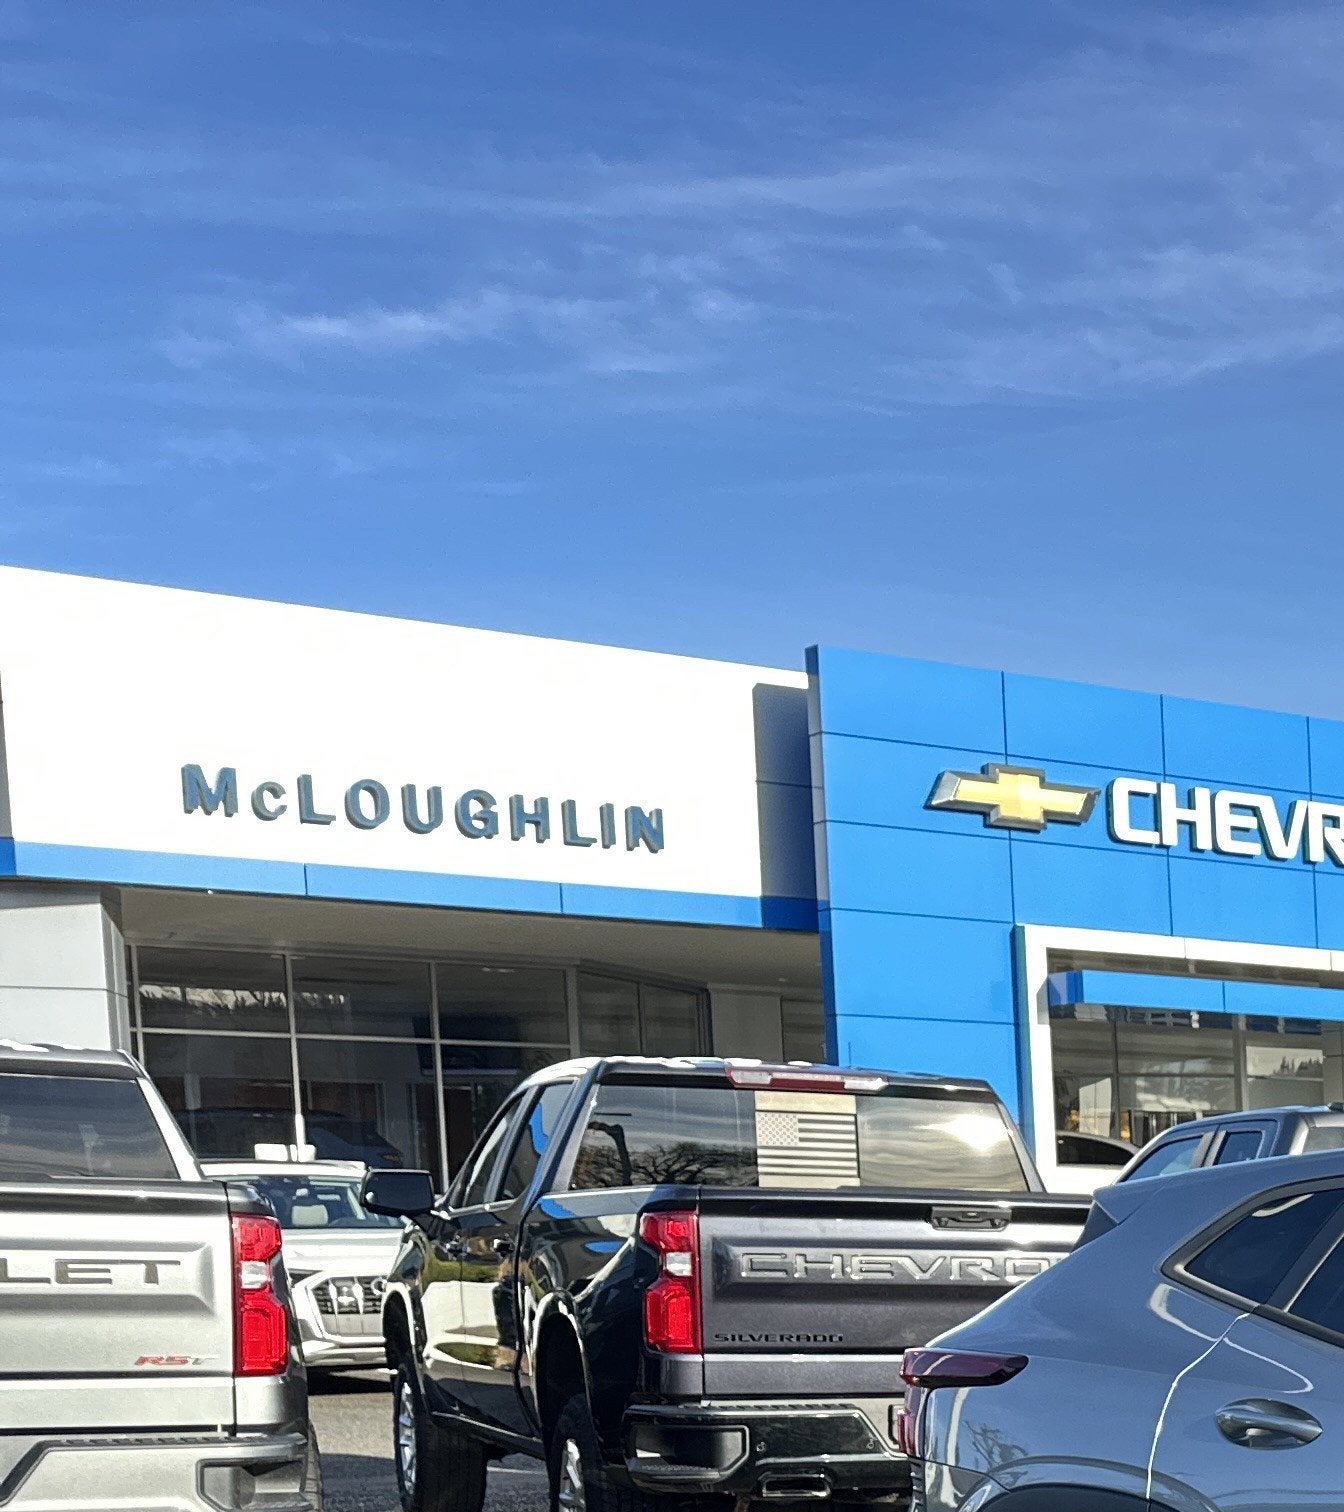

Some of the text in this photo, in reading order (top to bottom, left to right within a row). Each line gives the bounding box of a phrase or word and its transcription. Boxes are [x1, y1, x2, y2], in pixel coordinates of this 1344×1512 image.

[180, 763, 665, 854] McLOUGHLIN
[740, 1252, 1064, 1281] CHEVRO
[714, 1333, 844, 1344] SILVERADO
[134, 1355, 219, 1366] RST
